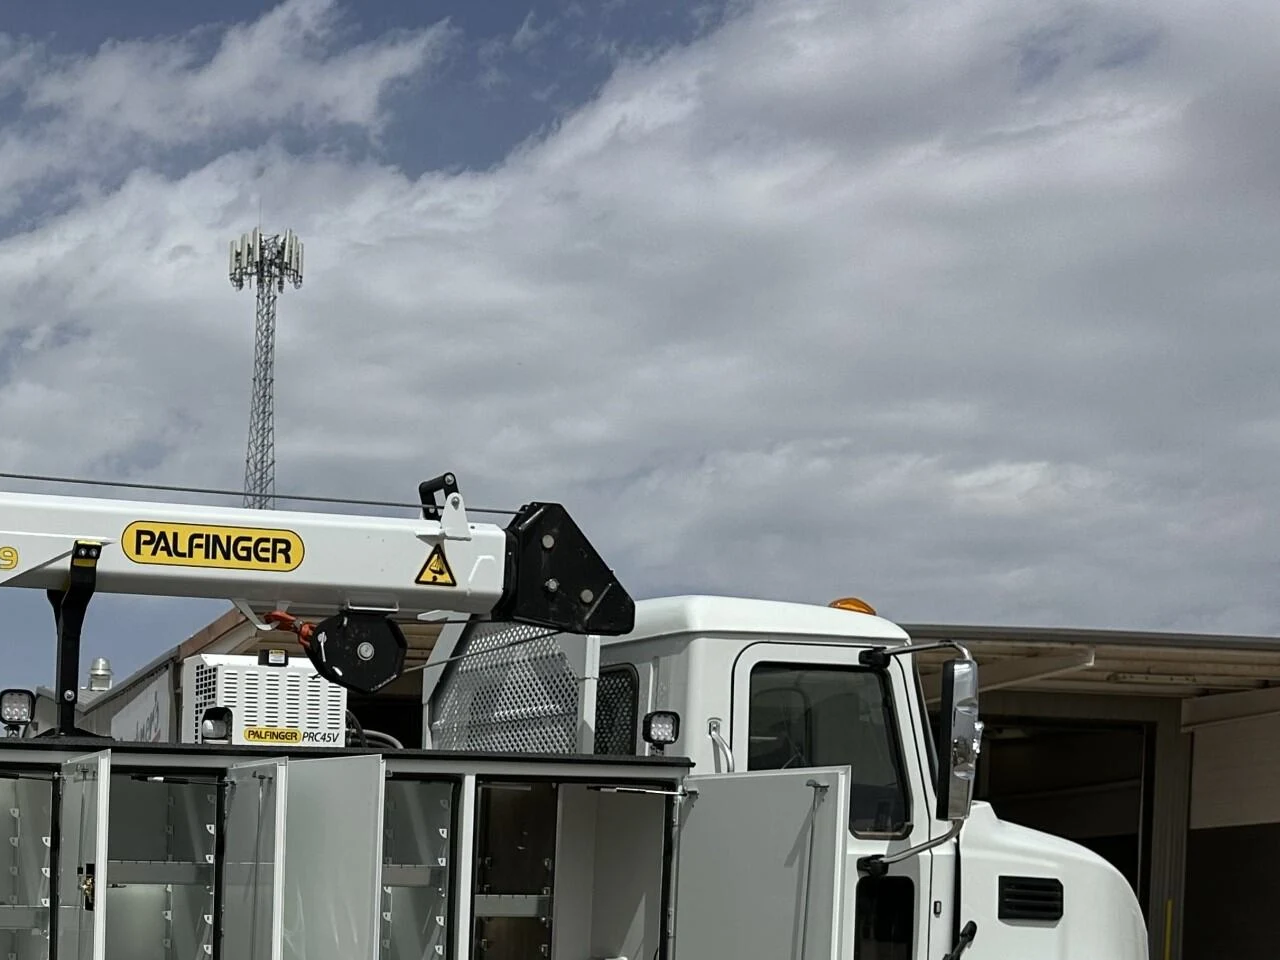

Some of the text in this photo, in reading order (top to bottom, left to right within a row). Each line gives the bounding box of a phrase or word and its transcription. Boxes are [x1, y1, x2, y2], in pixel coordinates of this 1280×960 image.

[135, 529, 292, 565] PALFINGER
[247, 730, 340, 743] PALFINGER PRC45V
